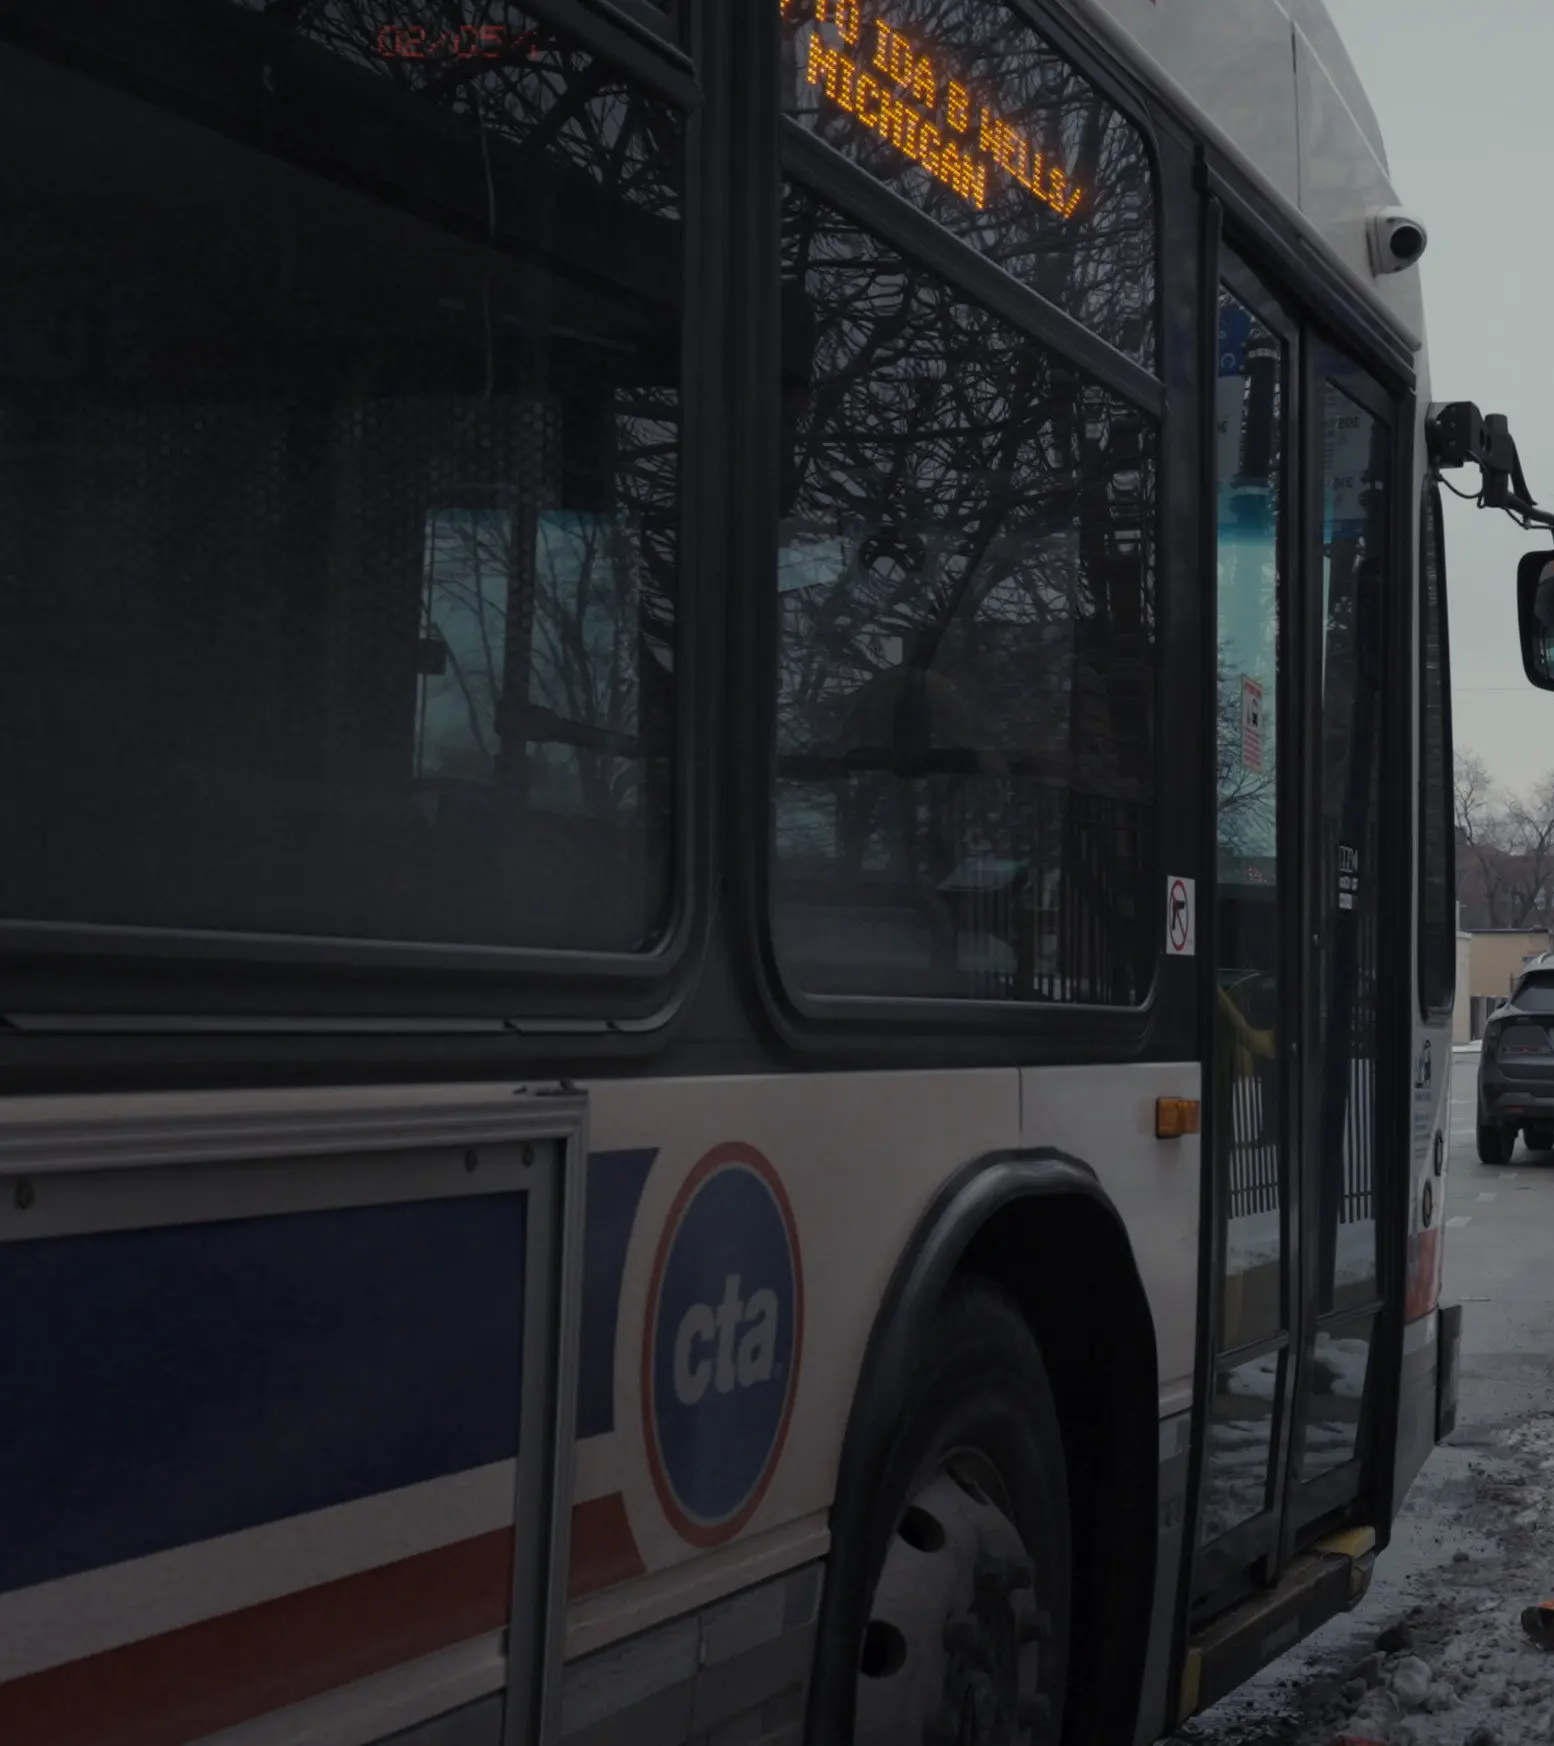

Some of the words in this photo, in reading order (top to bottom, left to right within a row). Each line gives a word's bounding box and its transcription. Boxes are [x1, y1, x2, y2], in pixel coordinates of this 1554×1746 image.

[806, 31, 986, 210] MICHIGAN
[873, 17, 936, 109] IDA
[947, 80, 969, 133] B
[979, 106, 1082, 220] WELLS/
[673, 1272, 780, 1407] cta
